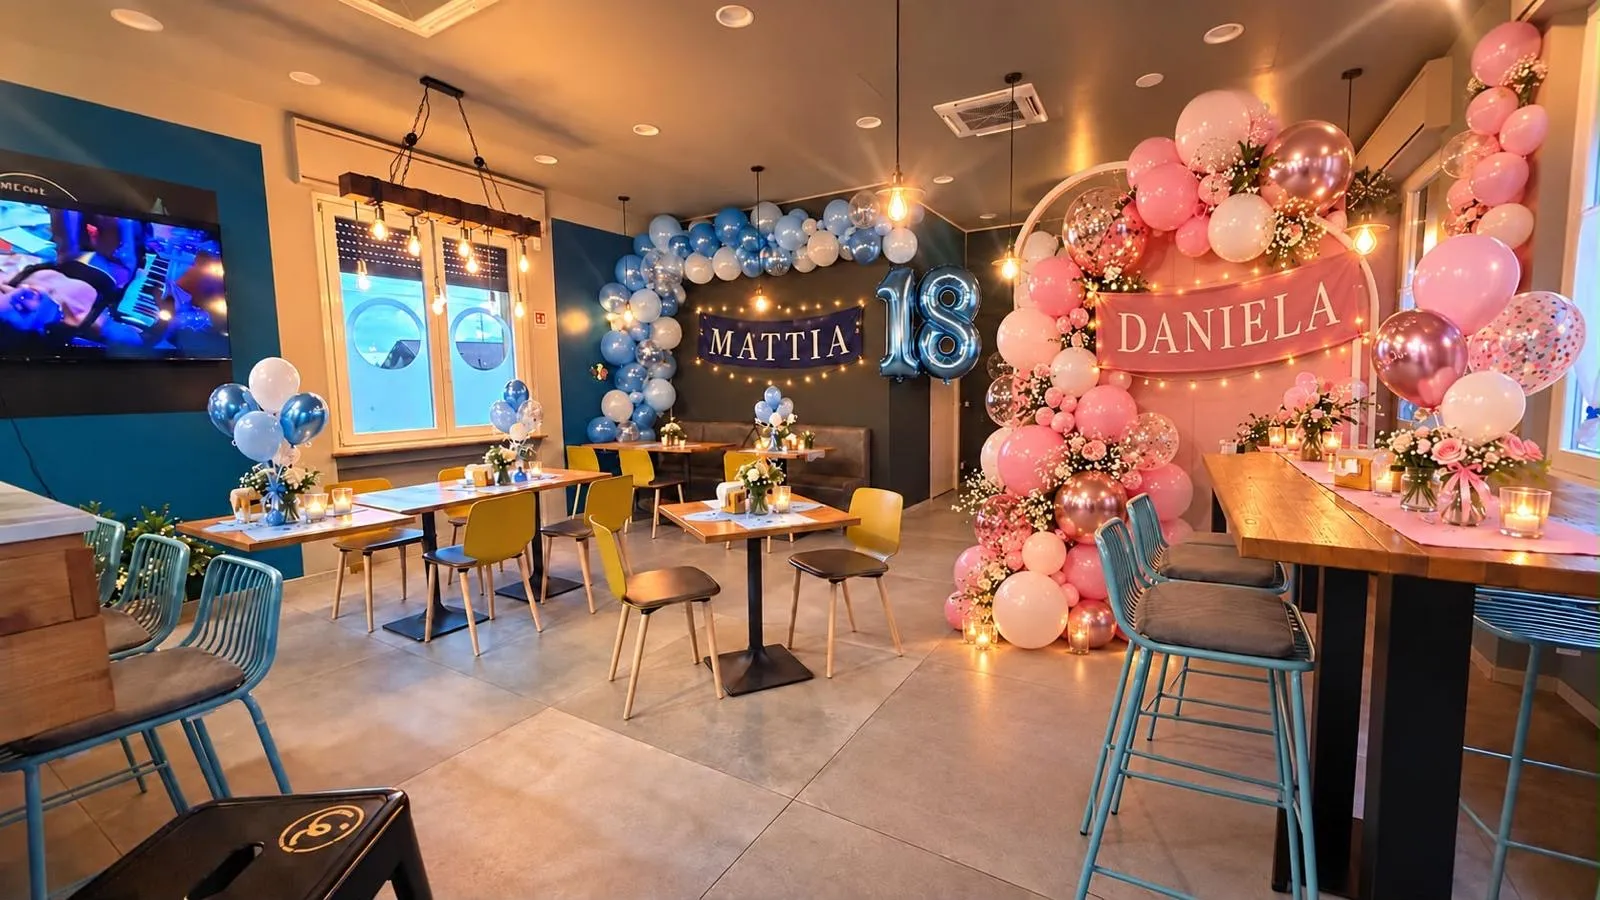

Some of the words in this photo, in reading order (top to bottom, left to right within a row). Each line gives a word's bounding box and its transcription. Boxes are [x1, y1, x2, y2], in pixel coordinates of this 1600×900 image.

[708, 324, 850, 361] MATTIA
[876, 265, 982, 380] 18
[1117, 280, 1341, 354] DANIELA
